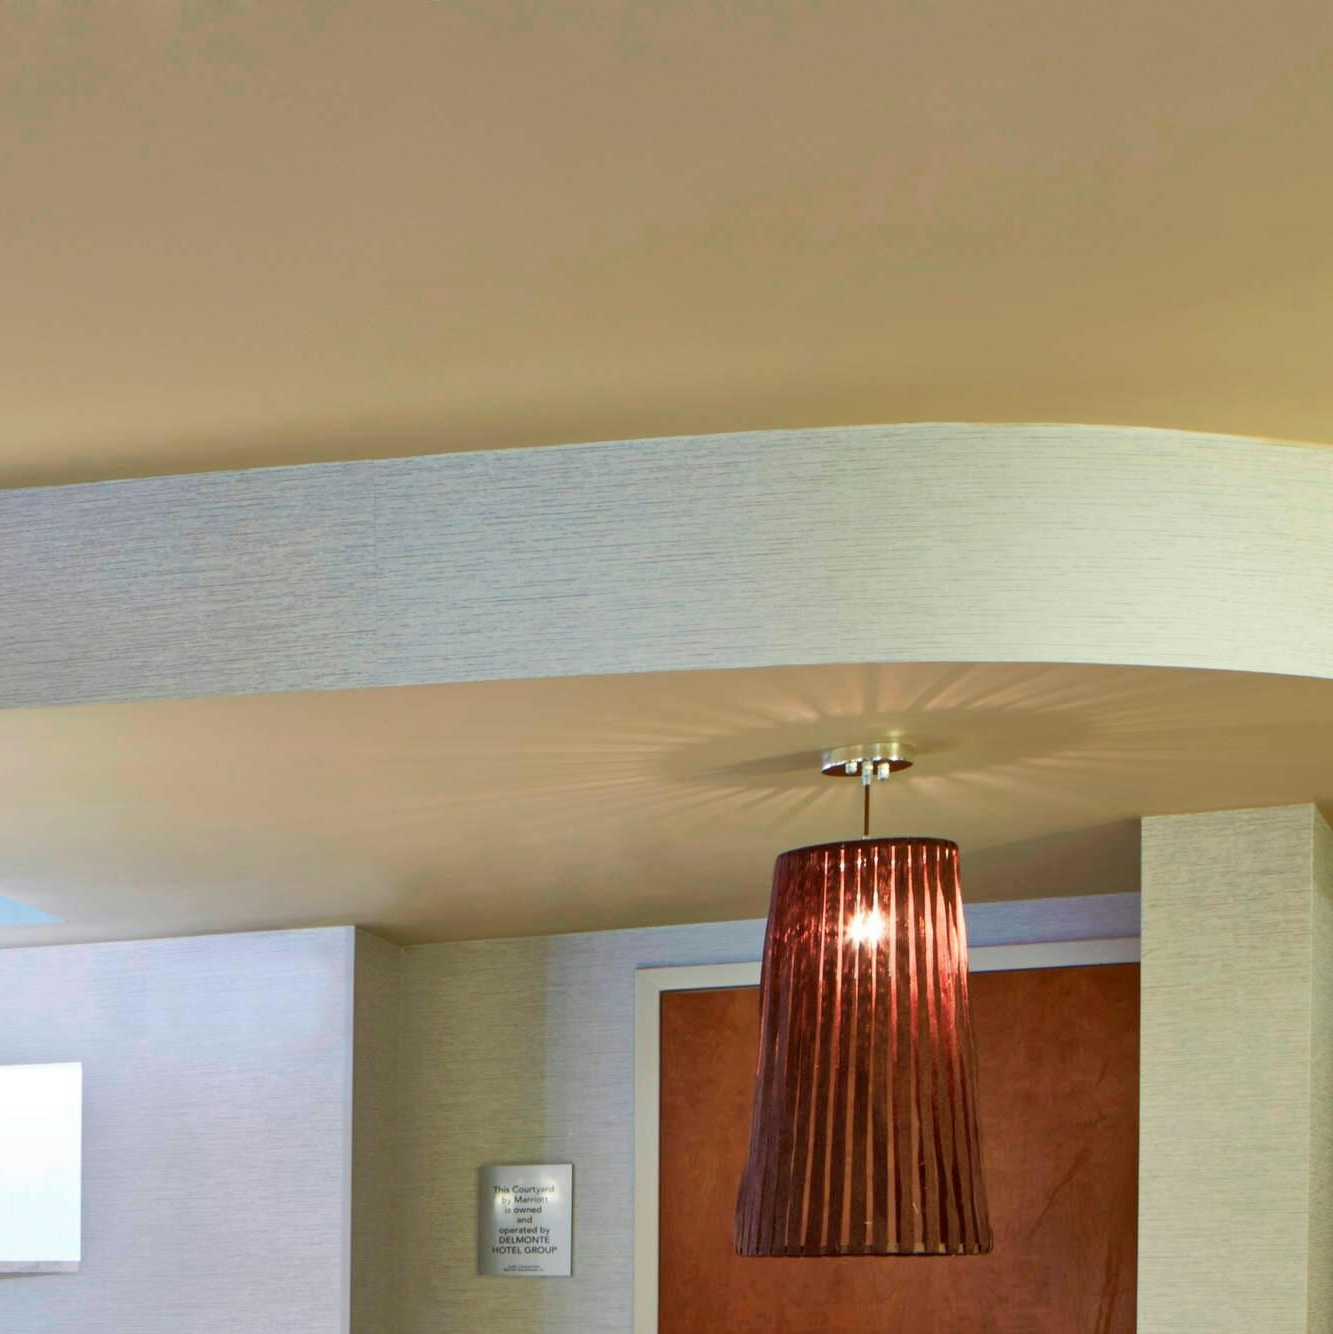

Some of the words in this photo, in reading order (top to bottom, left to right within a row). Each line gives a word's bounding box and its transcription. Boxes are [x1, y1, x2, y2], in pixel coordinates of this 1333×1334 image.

[493, 1185, 509, 1193] This
[512, 1185, 555, 1194] Courtyard
[499, 1226, 538, 1235] operated
[540, 1226, 550, 1235] by
[499, 1236, 550, 1244] DELMONTE
[492, 1246, 522, 1254] HOTEL
[524, 1246, 557, 1254] GROUP
